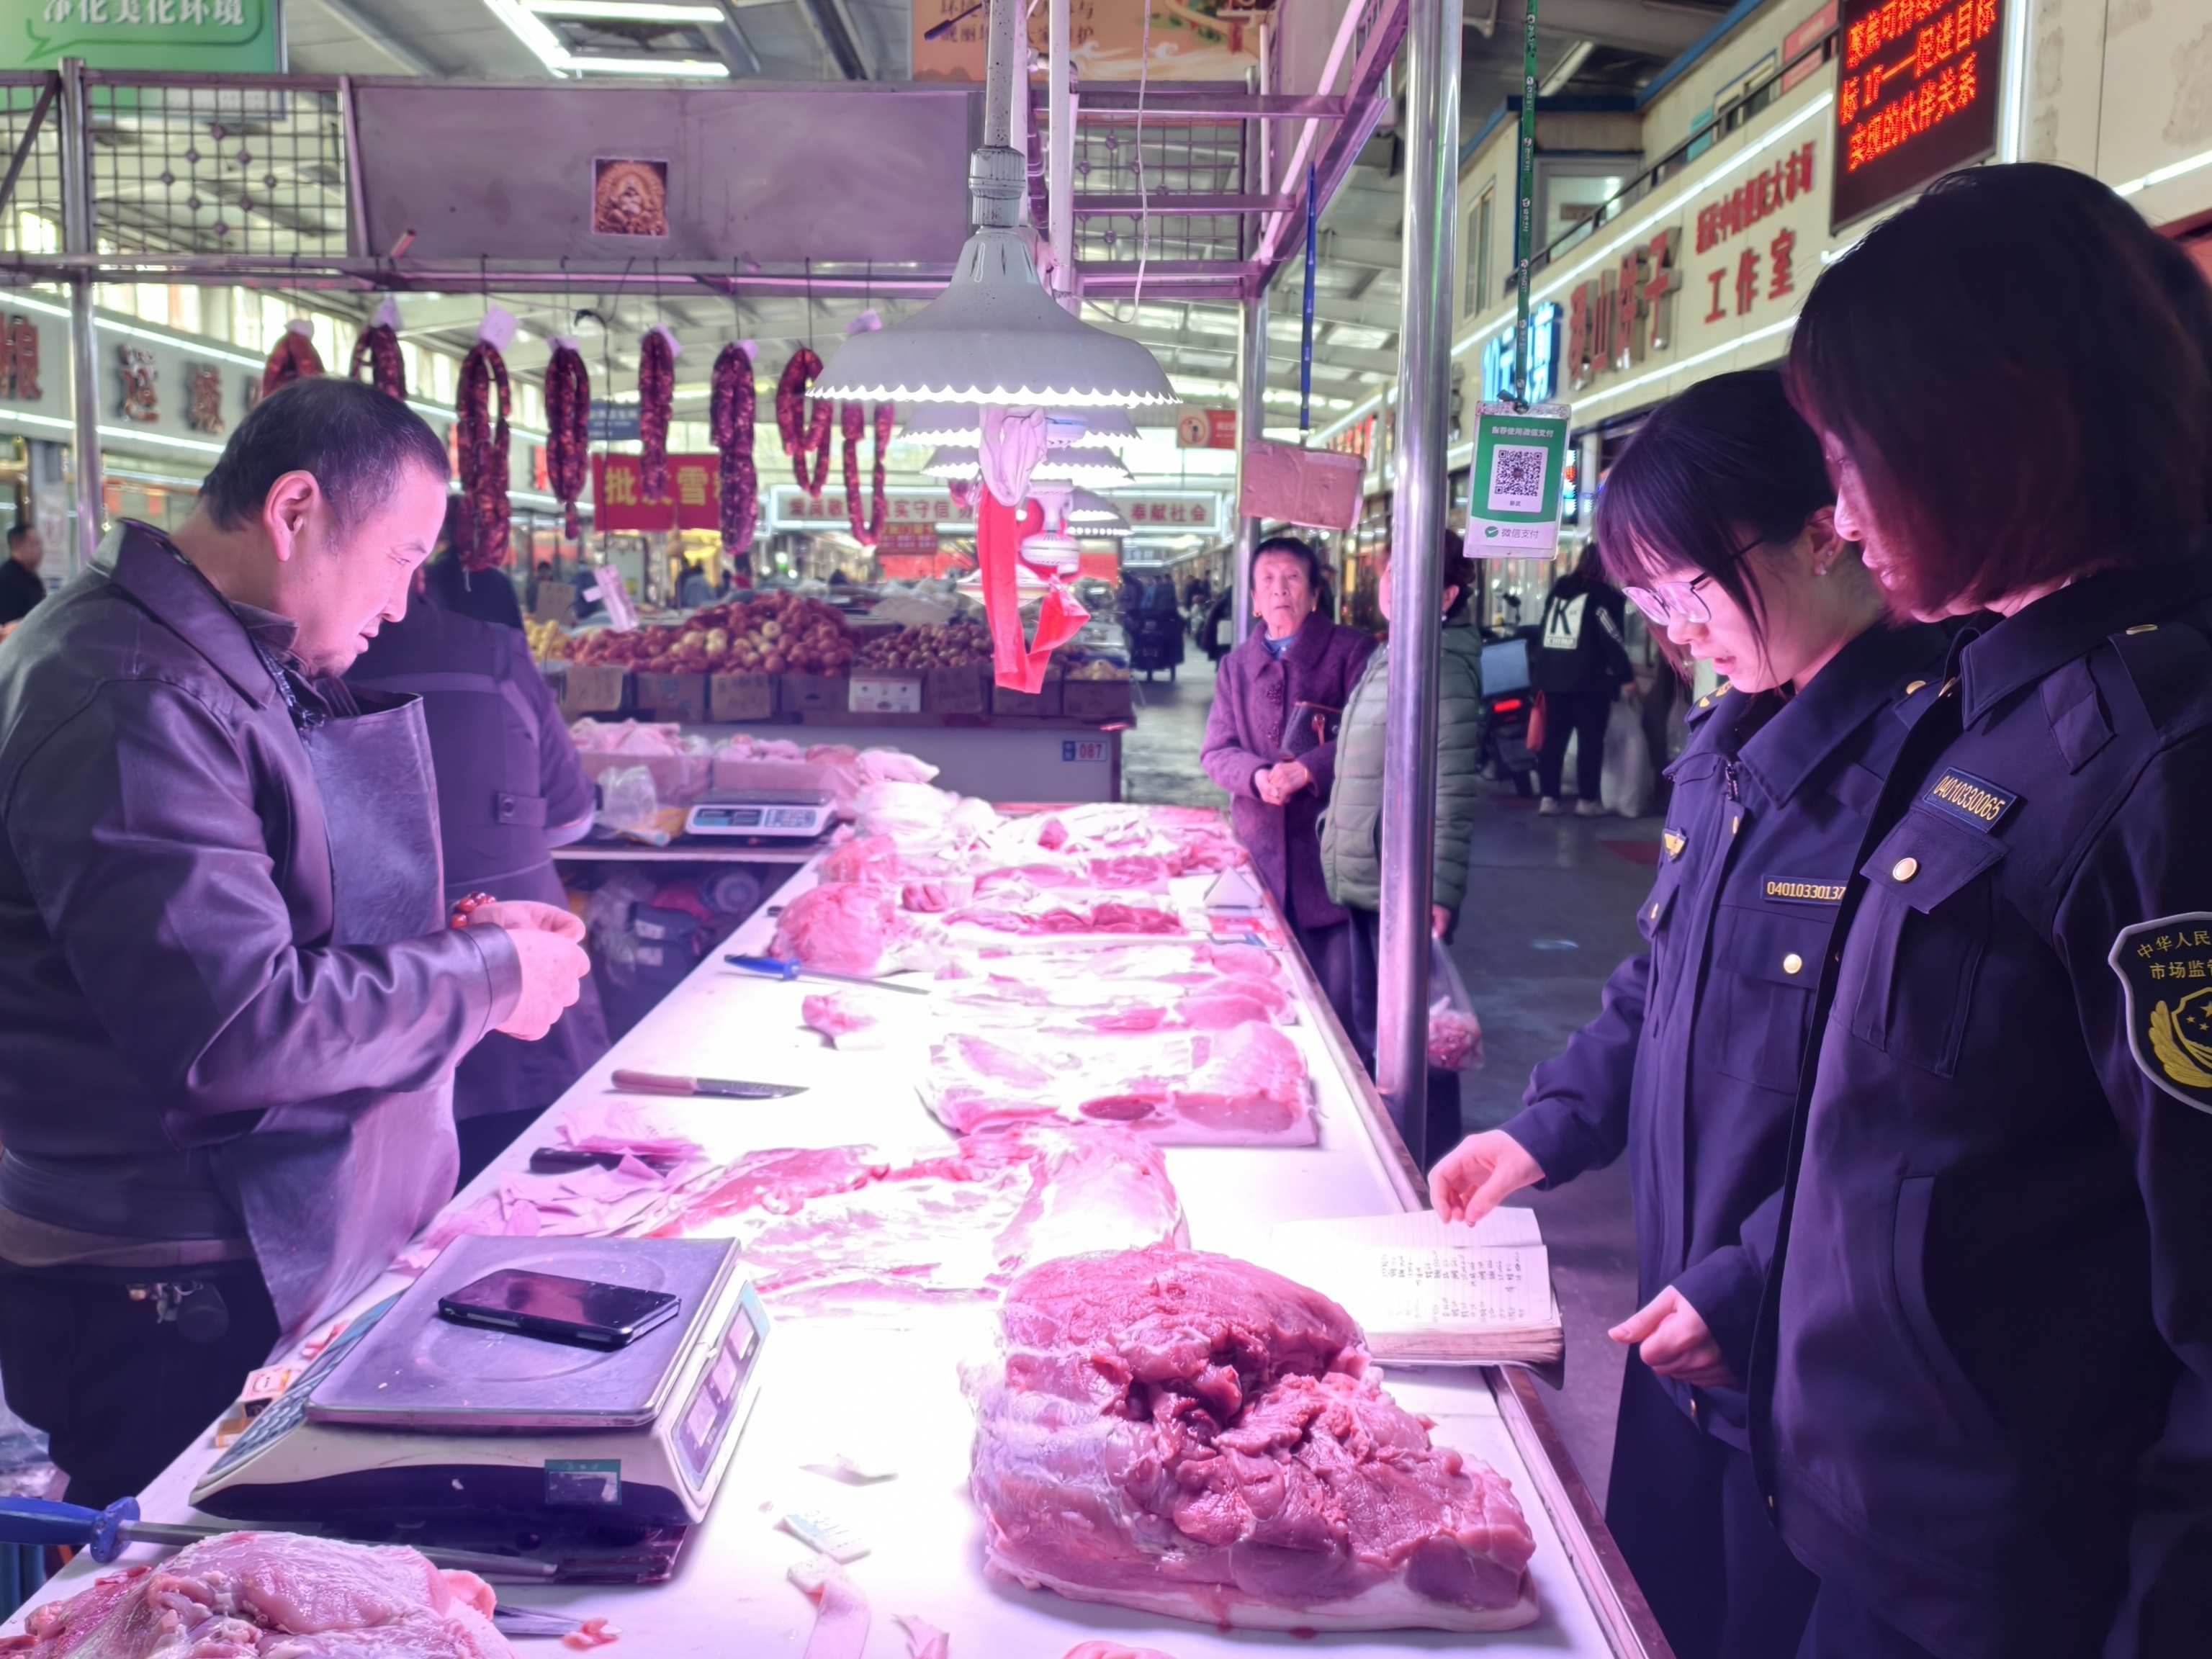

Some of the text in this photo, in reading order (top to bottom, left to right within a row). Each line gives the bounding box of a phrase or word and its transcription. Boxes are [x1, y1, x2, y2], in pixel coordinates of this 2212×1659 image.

[1849, 51, 1976, 171] 实现的伙伴关系
[1704, 228, 1793, 324] 工作室
[789, 498, 844, 516] 爱岗敬
[884, 500, 950, 518] 实守信
[1131, 503, 1207, 522] 奉献社会
[1501, 529, 1539, 539] 微信支付
[1550, 598, 1571, 635] K
[1079, 743, 1102, 759] 087
[1933, 775, 2005, 821] 04010330065
[1766, 881, 1846, 901] 04010330137
[2136, 930, 2212, 958] 中华人民
